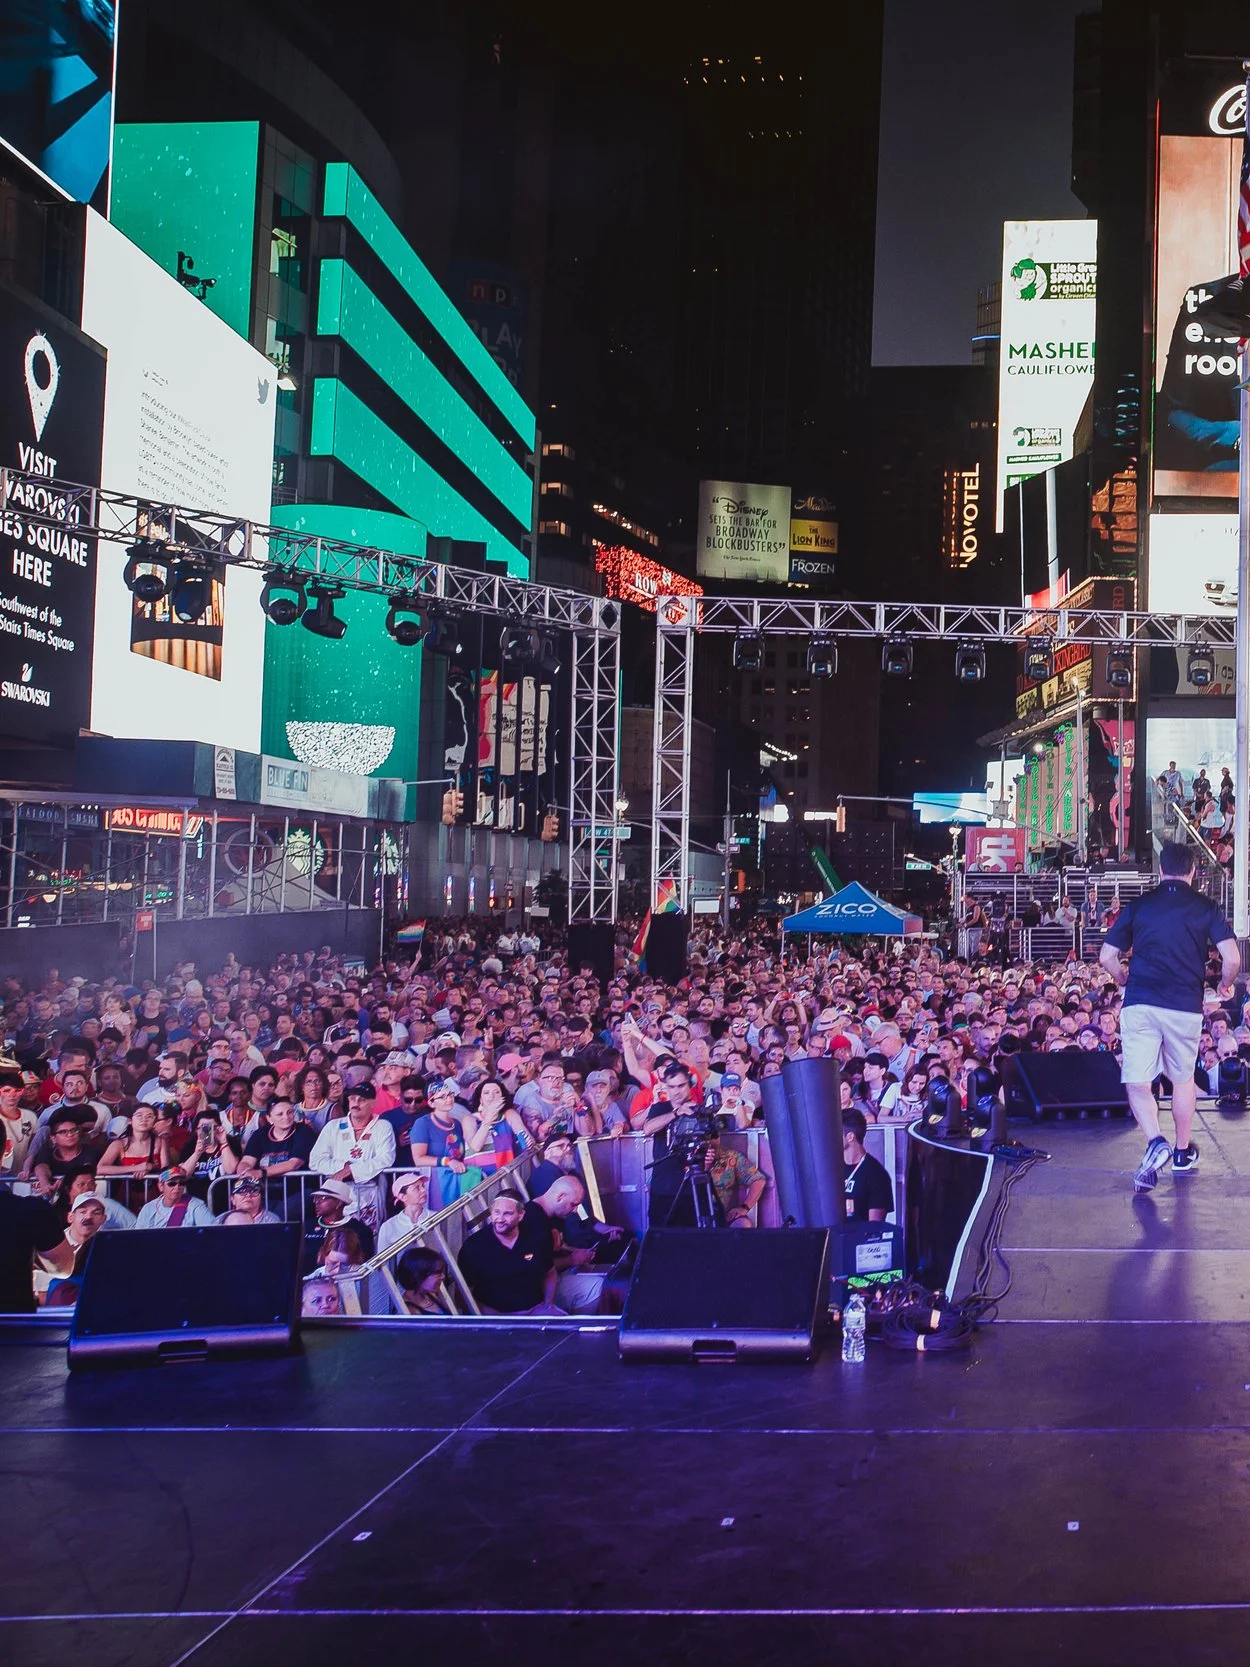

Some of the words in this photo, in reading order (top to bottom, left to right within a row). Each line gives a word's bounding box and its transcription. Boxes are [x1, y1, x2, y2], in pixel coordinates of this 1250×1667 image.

[1050, 273, 1097, 284] SPROUT
[1008, 365, 1096, 375] CAULIFLOWE
[19, 442, 57, 478] VISIT
[709, 514, 726, 525] SETS
[730, 516, 742, 526] THE
[746, 518, 760, 528] BAR
[763, 519, 777, 529] FOR
[959, 462, 980, 568] NOVOTEL
[716, 525, 770, 540] BROADWAY
[792, 533, 812, 546] LION
[814, 535, 835, 548] KING
[27, 525, 88, 567] SQUARE
[12, 549, 52, 587] HERE
[791, 559, 835, 574] FROZEN
[39, 606, 49, 623] of
[49, 608, 62, 627] the
[23, 621, 46, 643] Times
[47, 630, 75, 652] Square
[1, 681, 51, 707] SWAROVSKI
[268, 766, 290, 787] BLUE
[293, 771, 309, 791] FIN
[981, 834, 1016, 872] tk
[816, 903, 878, 915] ZICO
